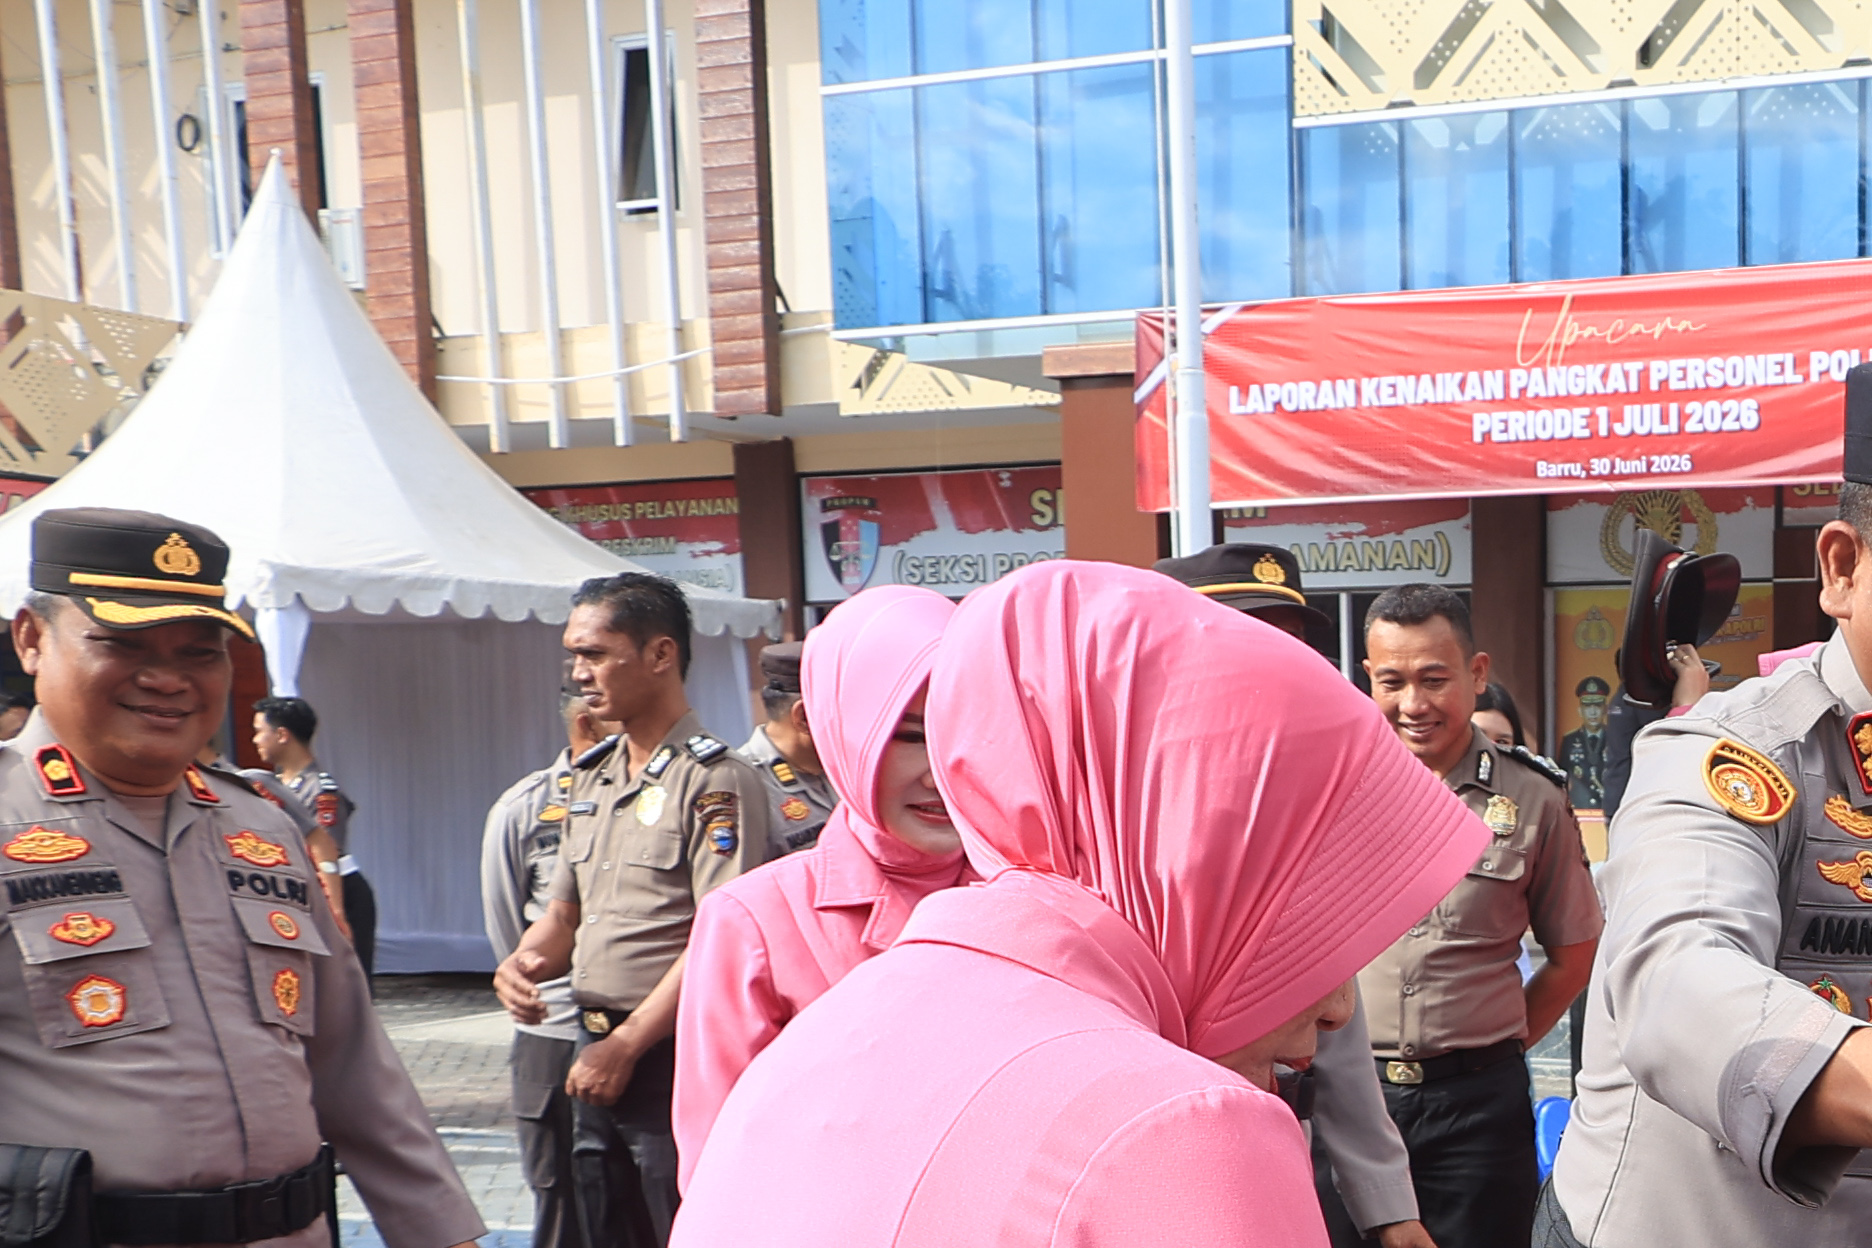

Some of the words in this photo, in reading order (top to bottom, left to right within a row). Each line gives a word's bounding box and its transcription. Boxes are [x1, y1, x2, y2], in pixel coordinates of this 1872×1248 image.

[1516, 293, 1706, 367] Upacara
[1229, 379, 1355, 414] LAPORAN
[1361, 370, 1503, 406] KENAIKAN
[1509, 361, 1644, 399] PANGKAT
[1650, 353, 1803, 391] PERSONEL
[1472, 407, 1591, 443] PERIODE
[1597, 406, 1608, 437] 1
[1613, 403, 1679, 436] JULI
[1684, 399, 1760, 432] 2026
[1536, 458, 1587, 478] Barru,
[1590, 457, 1610, 475] 30
[1613, 456, 1646, 474] Juni
[1650, 454, 1692, 472] 2026
[635, 498, 739, 518] PELAYANAN
[893, 550, 986, 584] (SEKSI
[227, 870, 307, 905] POLRI
